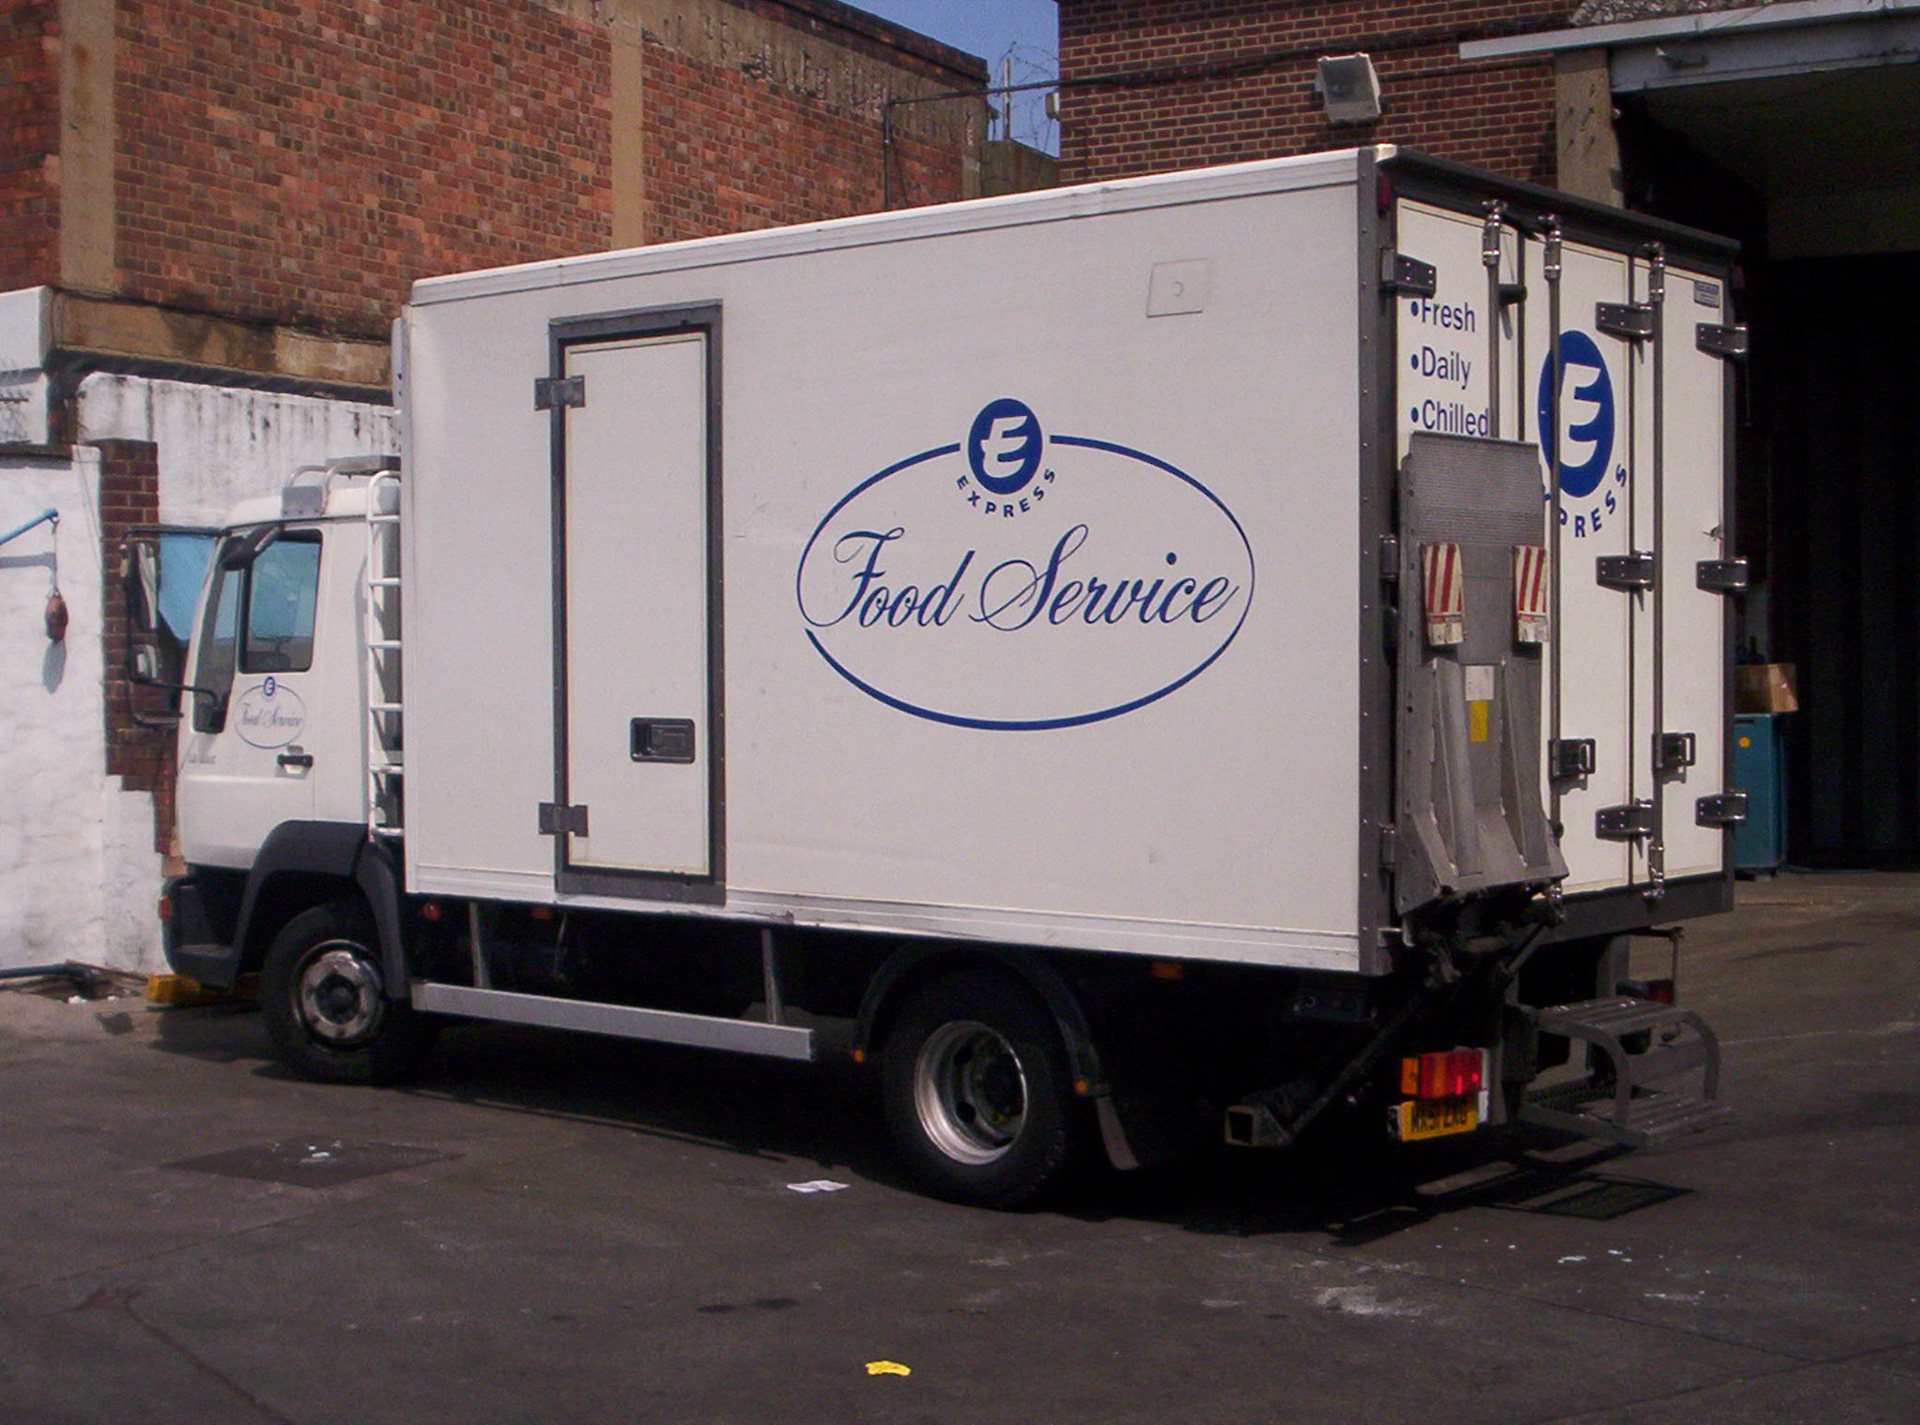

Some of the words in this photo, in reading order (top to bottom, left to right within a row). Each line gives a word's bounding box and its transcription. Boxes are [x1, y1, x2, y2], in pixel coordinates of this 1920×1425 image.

[1422, 297, 1475, 333] Fresh
[1422, 345, 1471, 390] Daily
[1422, 399, 1489, 437] Chilled
[956, 468, 1055, 518] EXPRESS
[806, 526, 975, 628] Food
[969, 523, 1239, 631] Service
